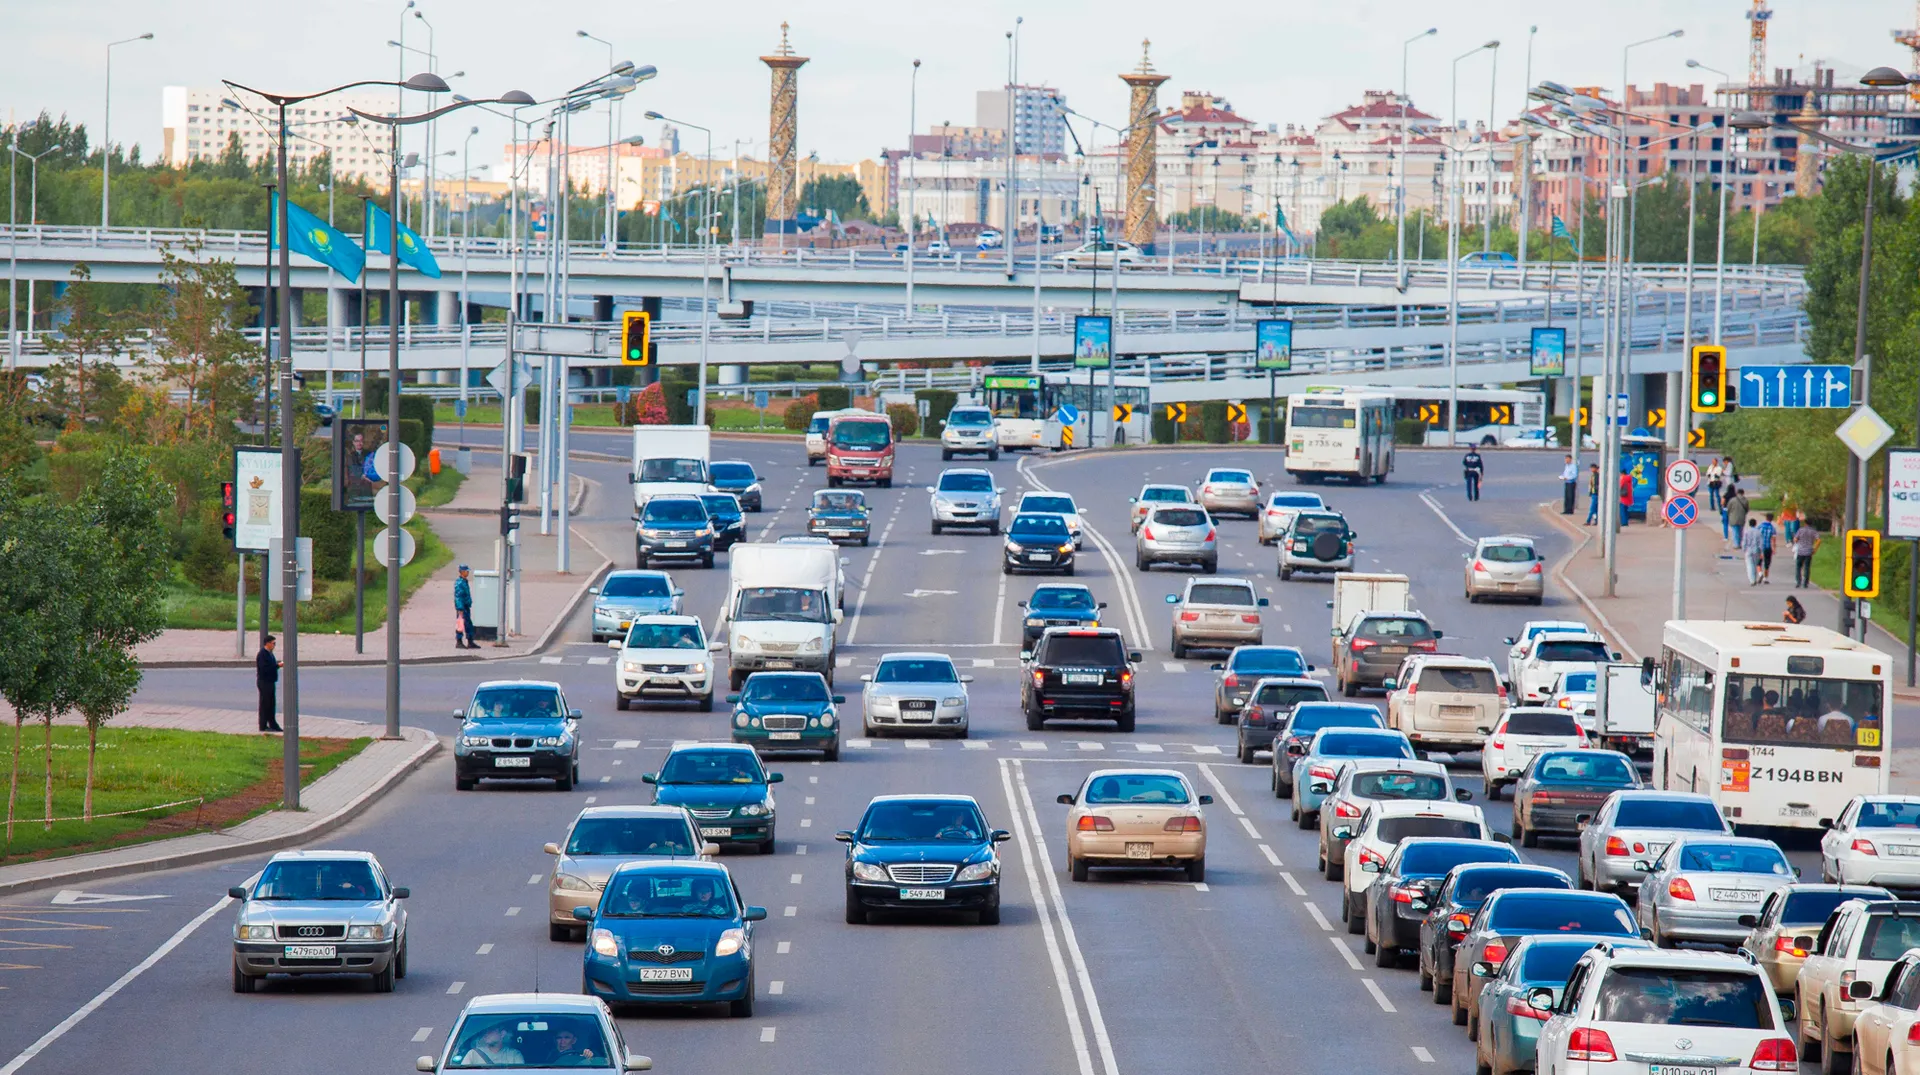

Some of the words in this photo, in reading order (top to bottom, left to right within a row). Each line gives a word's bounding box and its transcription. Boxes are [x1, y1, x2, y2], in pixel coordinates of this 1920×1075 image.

[1674, 470, 1692, 483] 50
[1862, 732, 1876, 744] 19
[1751, 746, 1775, 757] 1744
[1751, 766, 1843, 783] Z194BBN
[925, 890, 943, 898] ADM
[1724, 892, 1739, 900] 440
[1740, 892, 1758, 900] SYM
[652, 970, 668, 979] 727
[670, 970, 690, 979] BVN
